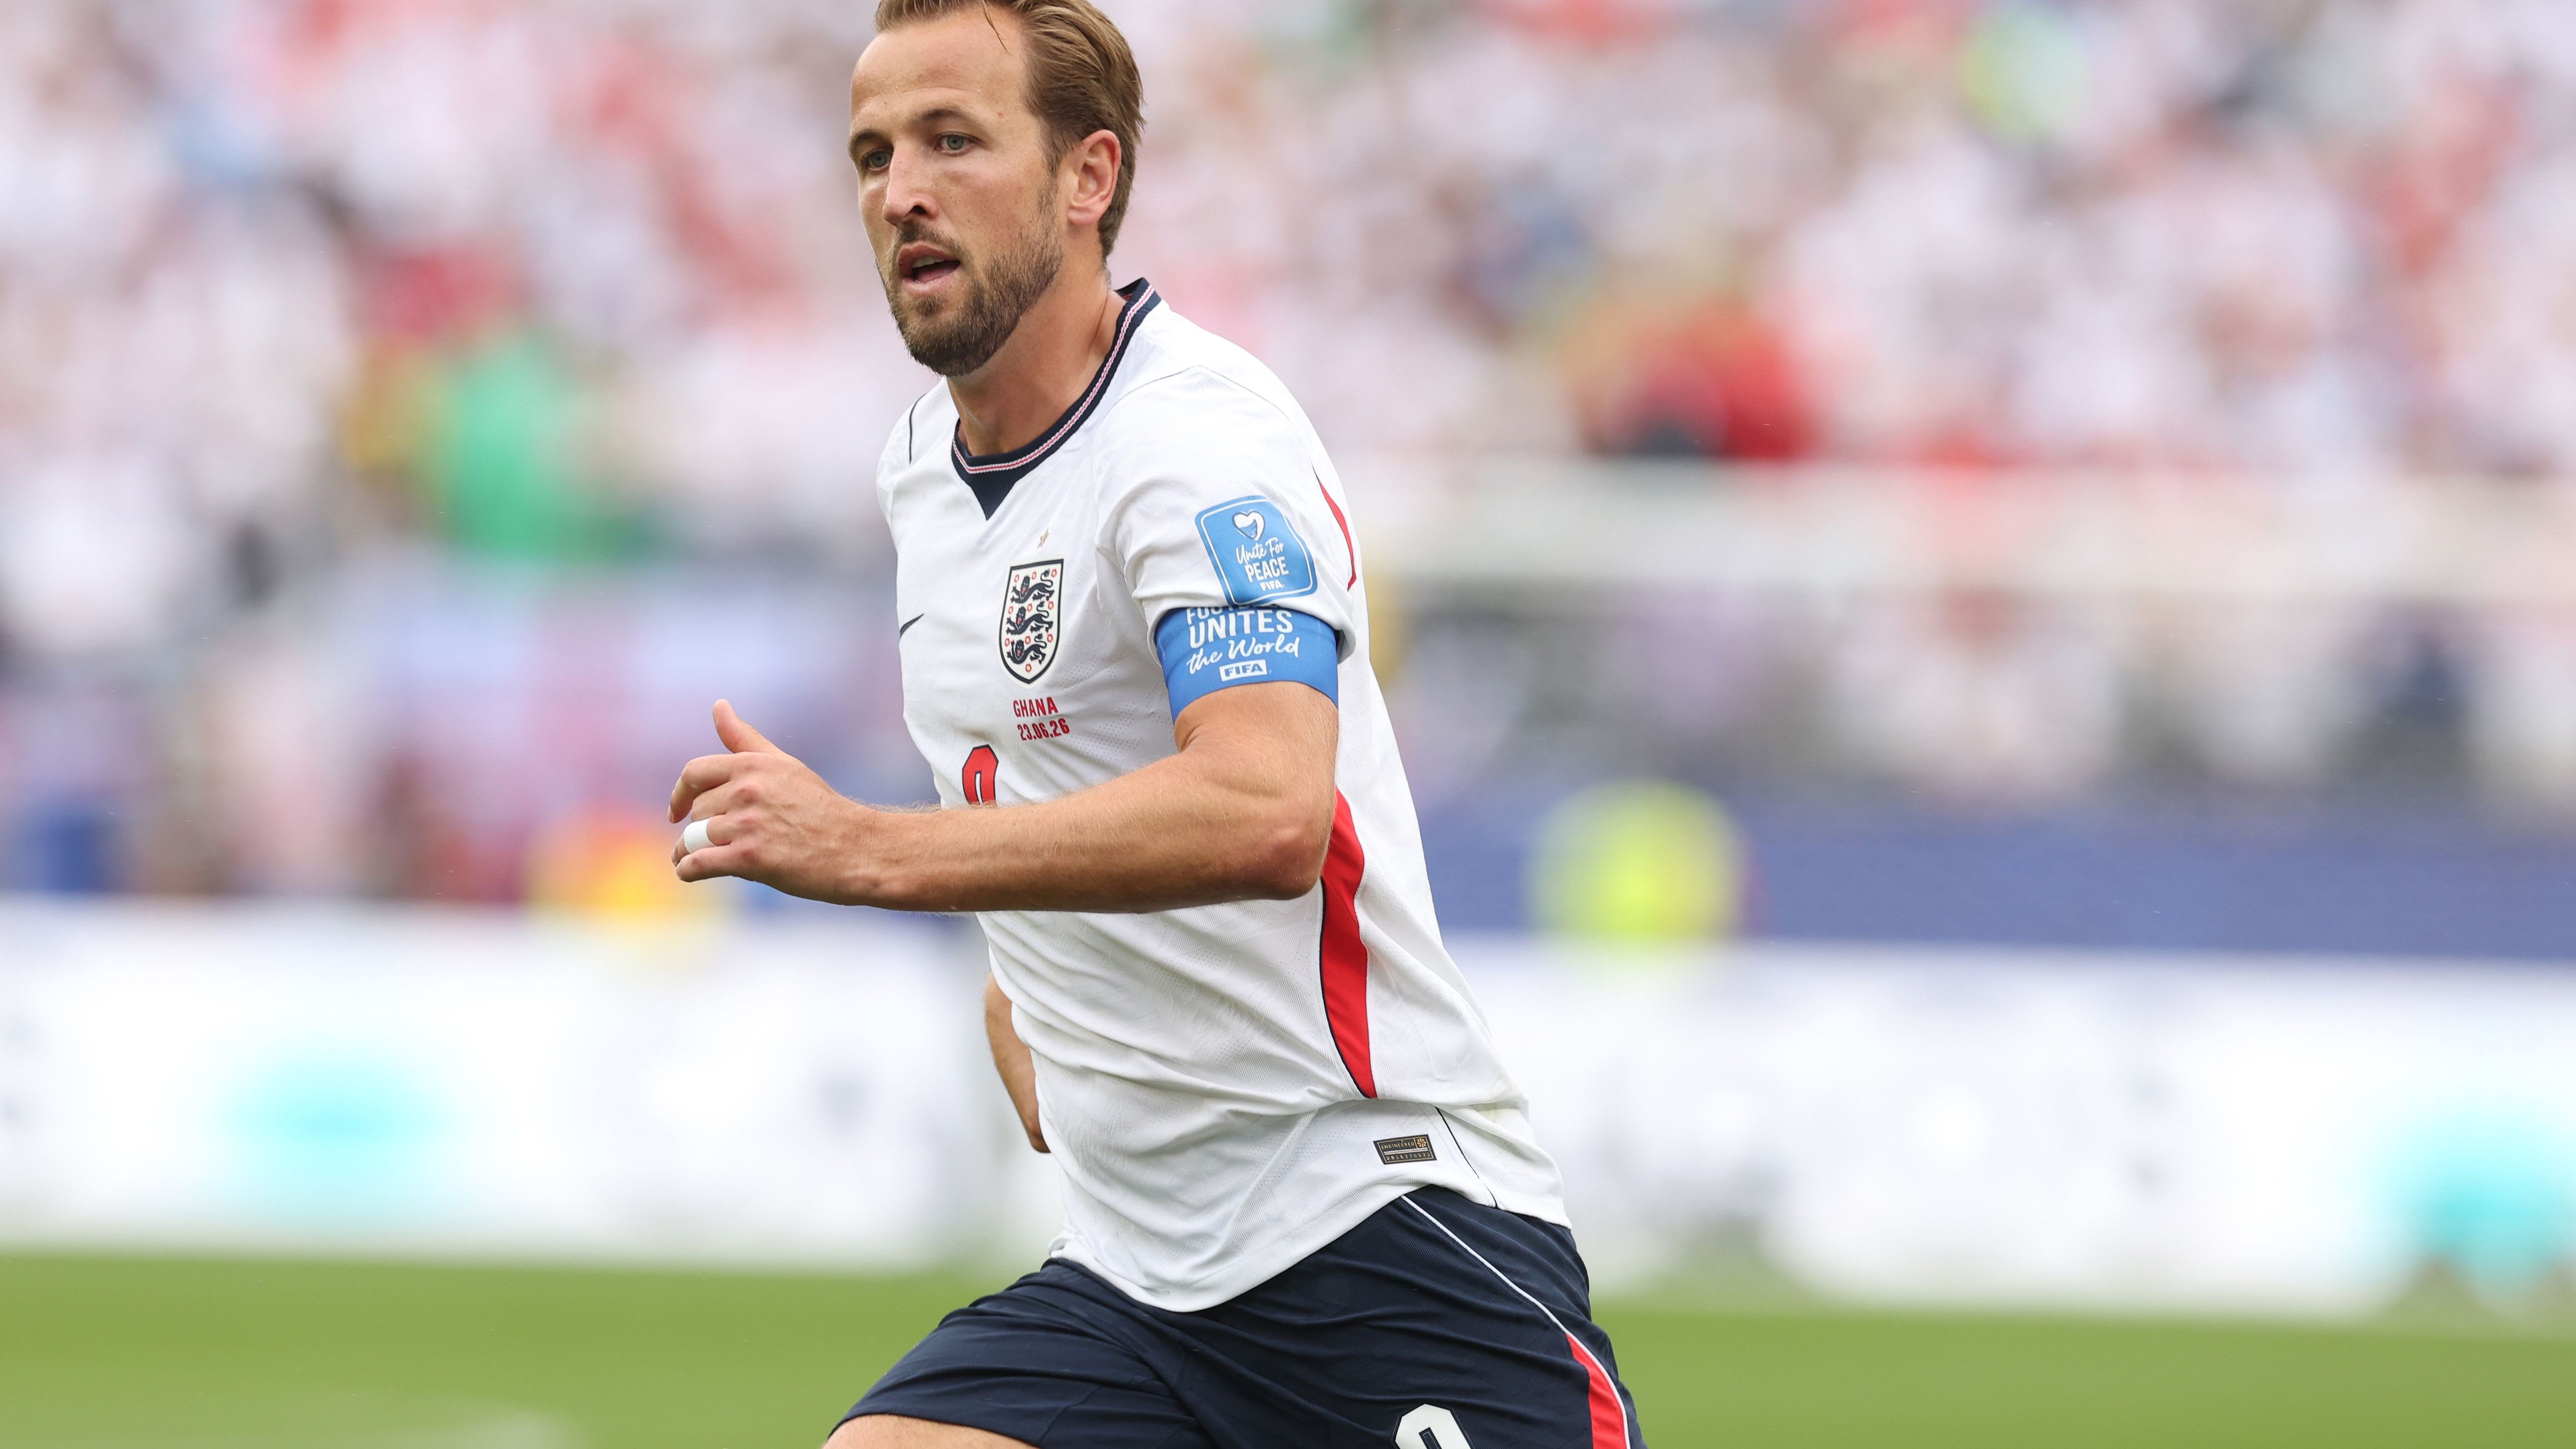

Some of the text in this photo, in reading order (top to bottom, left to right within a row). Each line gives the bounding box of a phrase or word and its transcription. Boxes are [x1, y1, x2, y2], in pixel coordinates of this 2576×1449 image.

[1236, 537, 1284, 565] Unite For
[1244, 556, 1290, 583] PEACE
[1260, 579, 1283, 591] FIFA
[1189, 609, 1294, 648] UNITES
[1186, 633, 1300, 675] the World
[1224, 663, 1264, 677] FIFA
[1013, 696, 1059, 718] GHANA
[1017, 718, 1070, 741] 23.06.26
